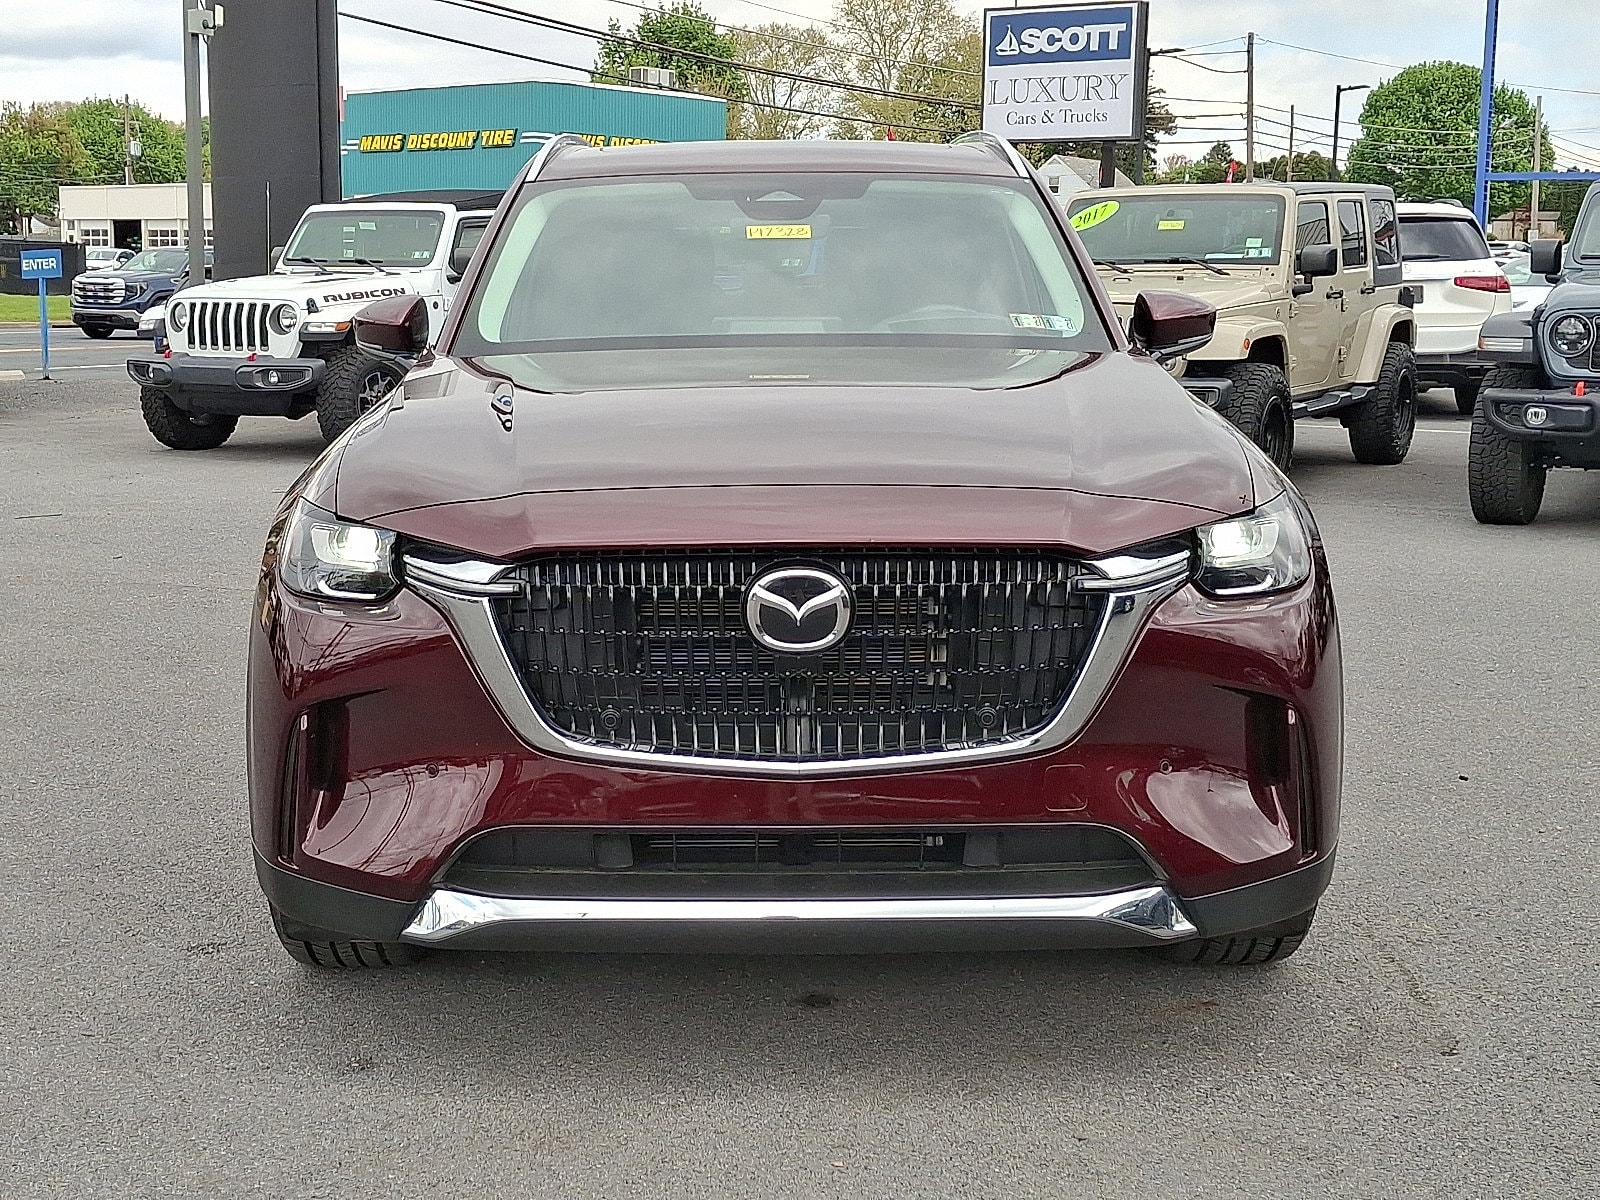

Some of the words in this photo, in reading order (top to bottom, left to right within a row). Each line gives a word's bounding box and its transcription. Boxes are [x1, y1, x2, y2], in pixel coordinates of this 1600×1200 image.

[1020, 23, 1127, 54] SCOTT
[988, 73, 1129, 105] LUXURY
[1006, 110, 1037, 125] Cars
[1041, 109, 1055, 124] &
[1059, 108, 1108, 124] Trucks
[360, 134, 404, 152] MAVIS
[407, 131, 477, 151] DISCOUNT
[481, 129, 516, 147] TIRE
[1074, 204, 1108, 229] 2017
[22, 257, 57, 271] ENTER
[323, 288, 406, 303] RUBICON
